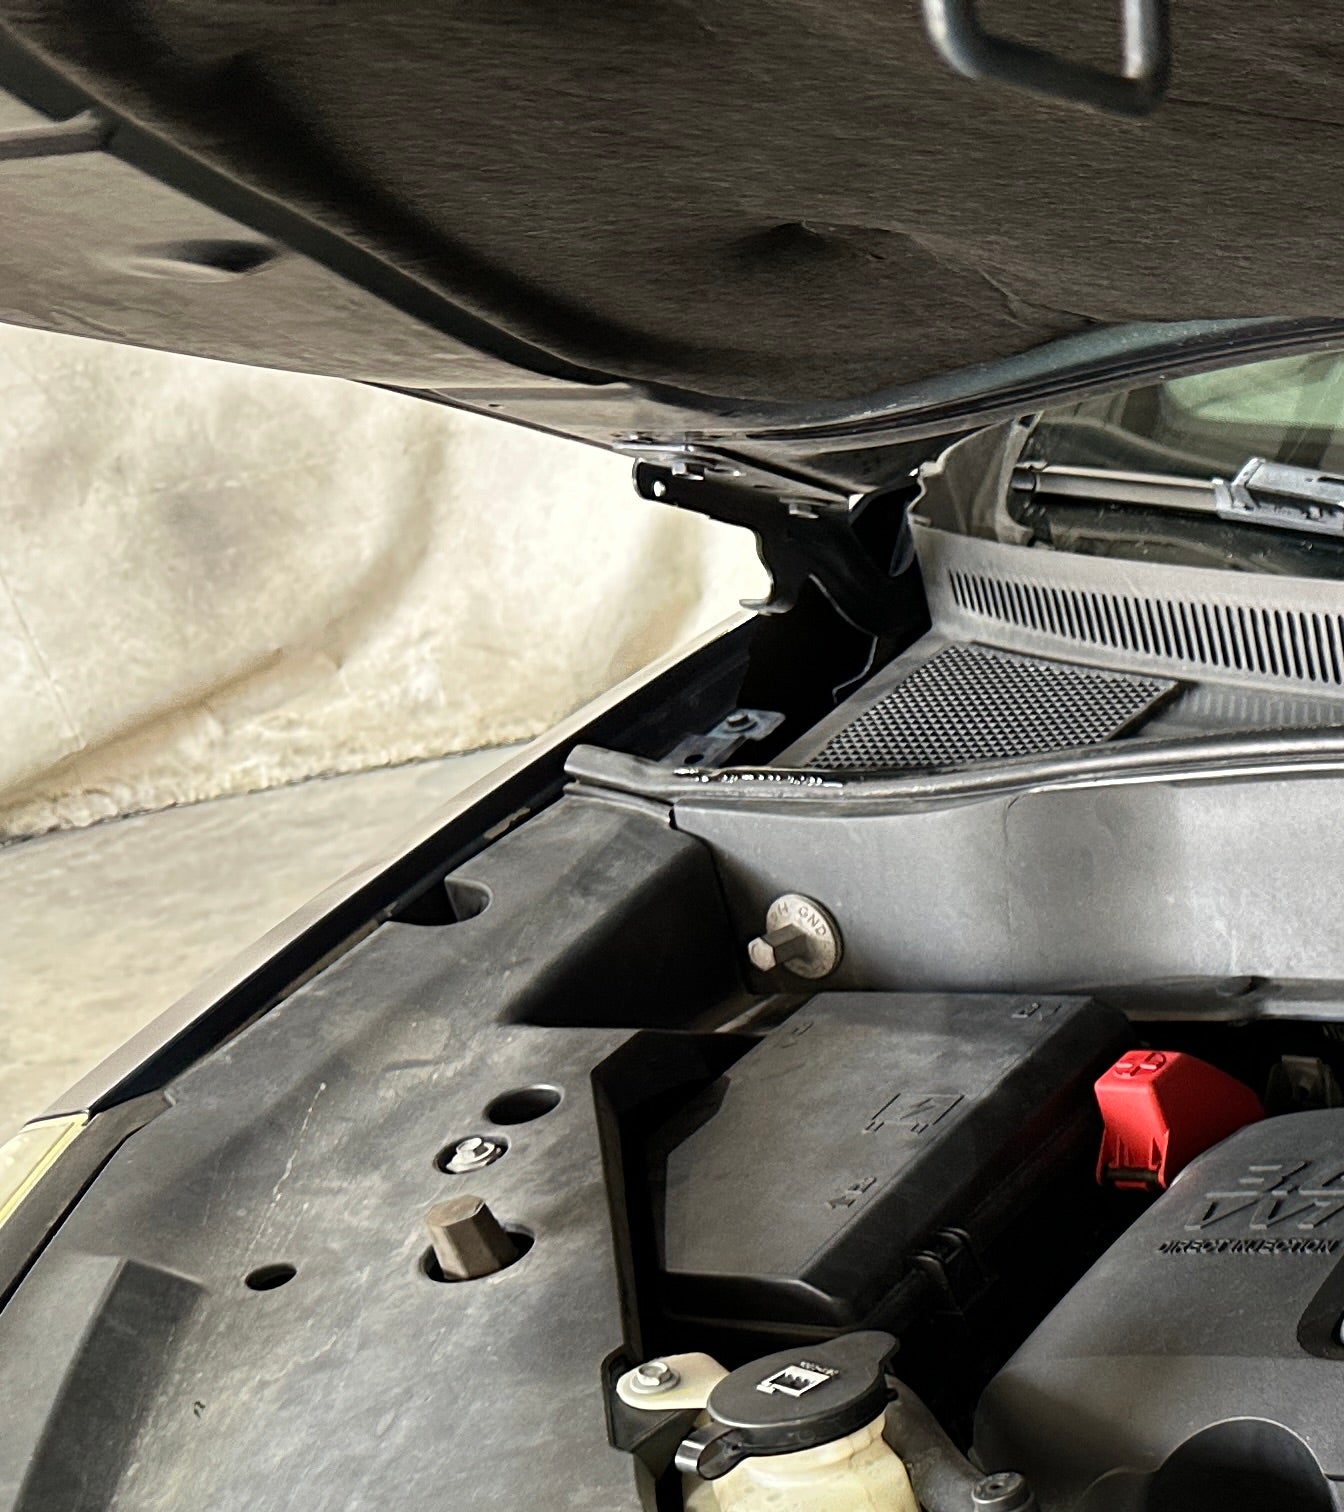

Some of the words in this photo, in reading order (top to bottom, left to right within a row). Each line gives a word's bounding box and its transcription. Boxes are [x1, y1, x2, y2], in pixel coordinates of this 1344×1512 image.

[799, 906, 826, 936] GND
[1158, 1238, 1232, 1254] DIRECT
[1226, 1238, 1341, 1255] INJECTION
